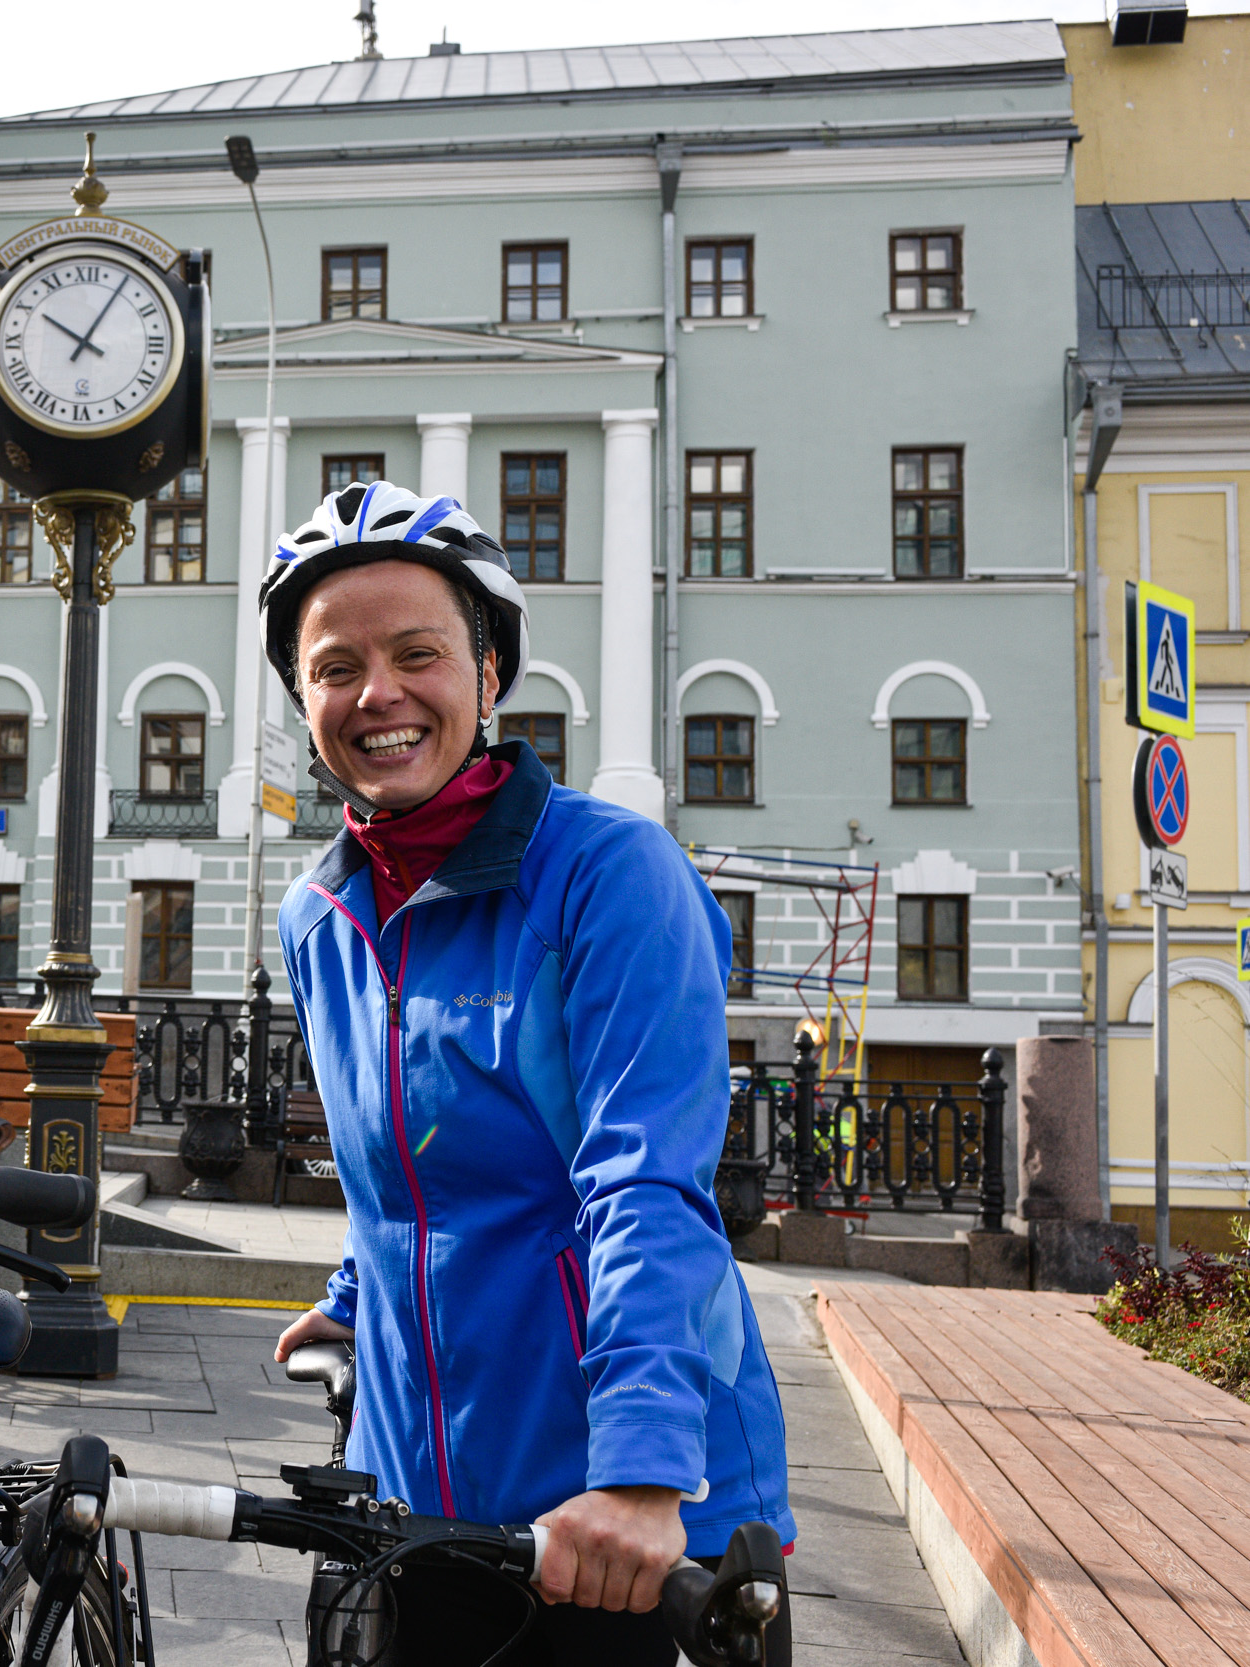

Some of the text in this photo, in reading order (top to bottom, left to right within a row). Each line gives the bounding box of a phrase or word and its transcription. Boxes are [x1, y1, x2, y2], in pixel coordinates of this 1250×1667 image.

[3, 220, 173, 264] ЦЕНТРАЛЬНЫЙ РЫНОК
[40, 272, 63, 293] XI
[75, 266, 99, 283] XII
[15, 300, 33, 315] X
[139, 302, 158, 318] II
[5, 333, 22, 350] IX
[148, 336, 165, 355] III
[8, 360, 33, 393] VIII
[136, 369, 157, 391] IV
[32, 390, 57, 416] VII
[113, 398, 127, 414] V
[72, 405, 91, 421] VI
[32, 1600, 63, 1661] SHIMANO
